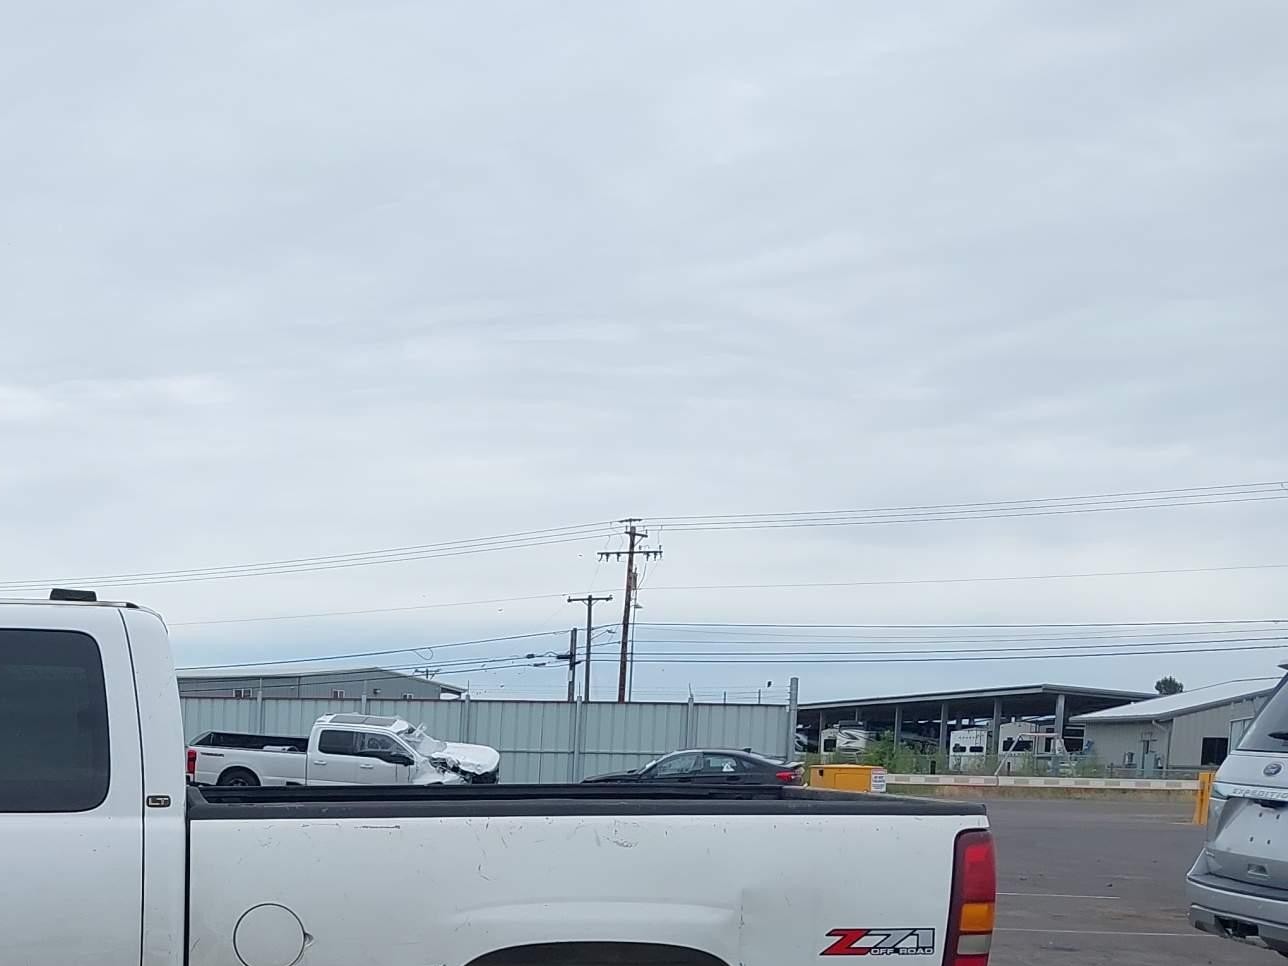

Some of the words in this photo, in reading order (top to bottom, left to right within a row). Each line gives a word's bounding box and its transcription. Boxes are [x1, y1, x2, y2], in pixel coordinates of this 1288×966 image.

[147, 796, 170, 807] LT
[819, 928, 935, 955] Z71
[871, 947, 895, 955] OFF
[898, 947, 934, 955] ROAD
